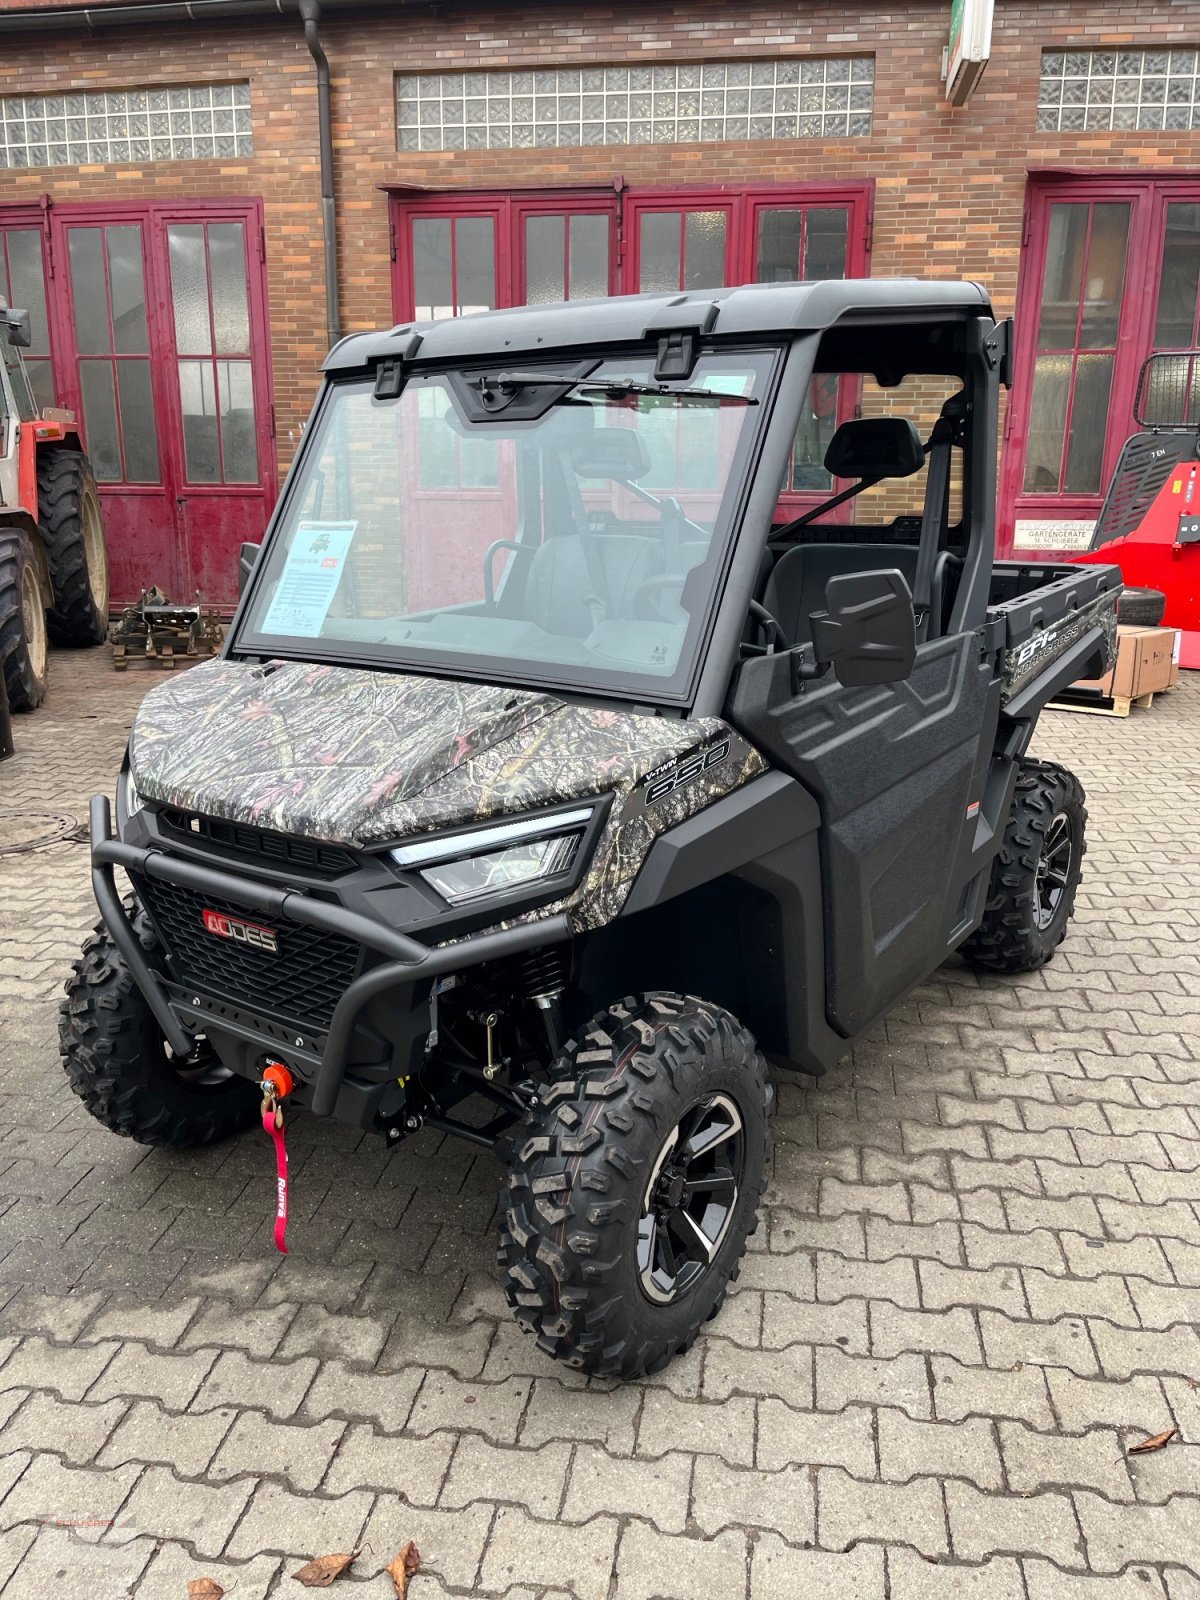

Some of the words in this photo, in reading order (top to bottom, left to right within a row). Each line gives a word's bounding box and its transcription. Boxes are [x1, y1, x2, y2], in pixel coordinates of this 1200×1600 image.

[645, 757, 678, 781] V-TWIN
[645, 739, 731, 807] 650
[208, 914, 277, 952] AODES
